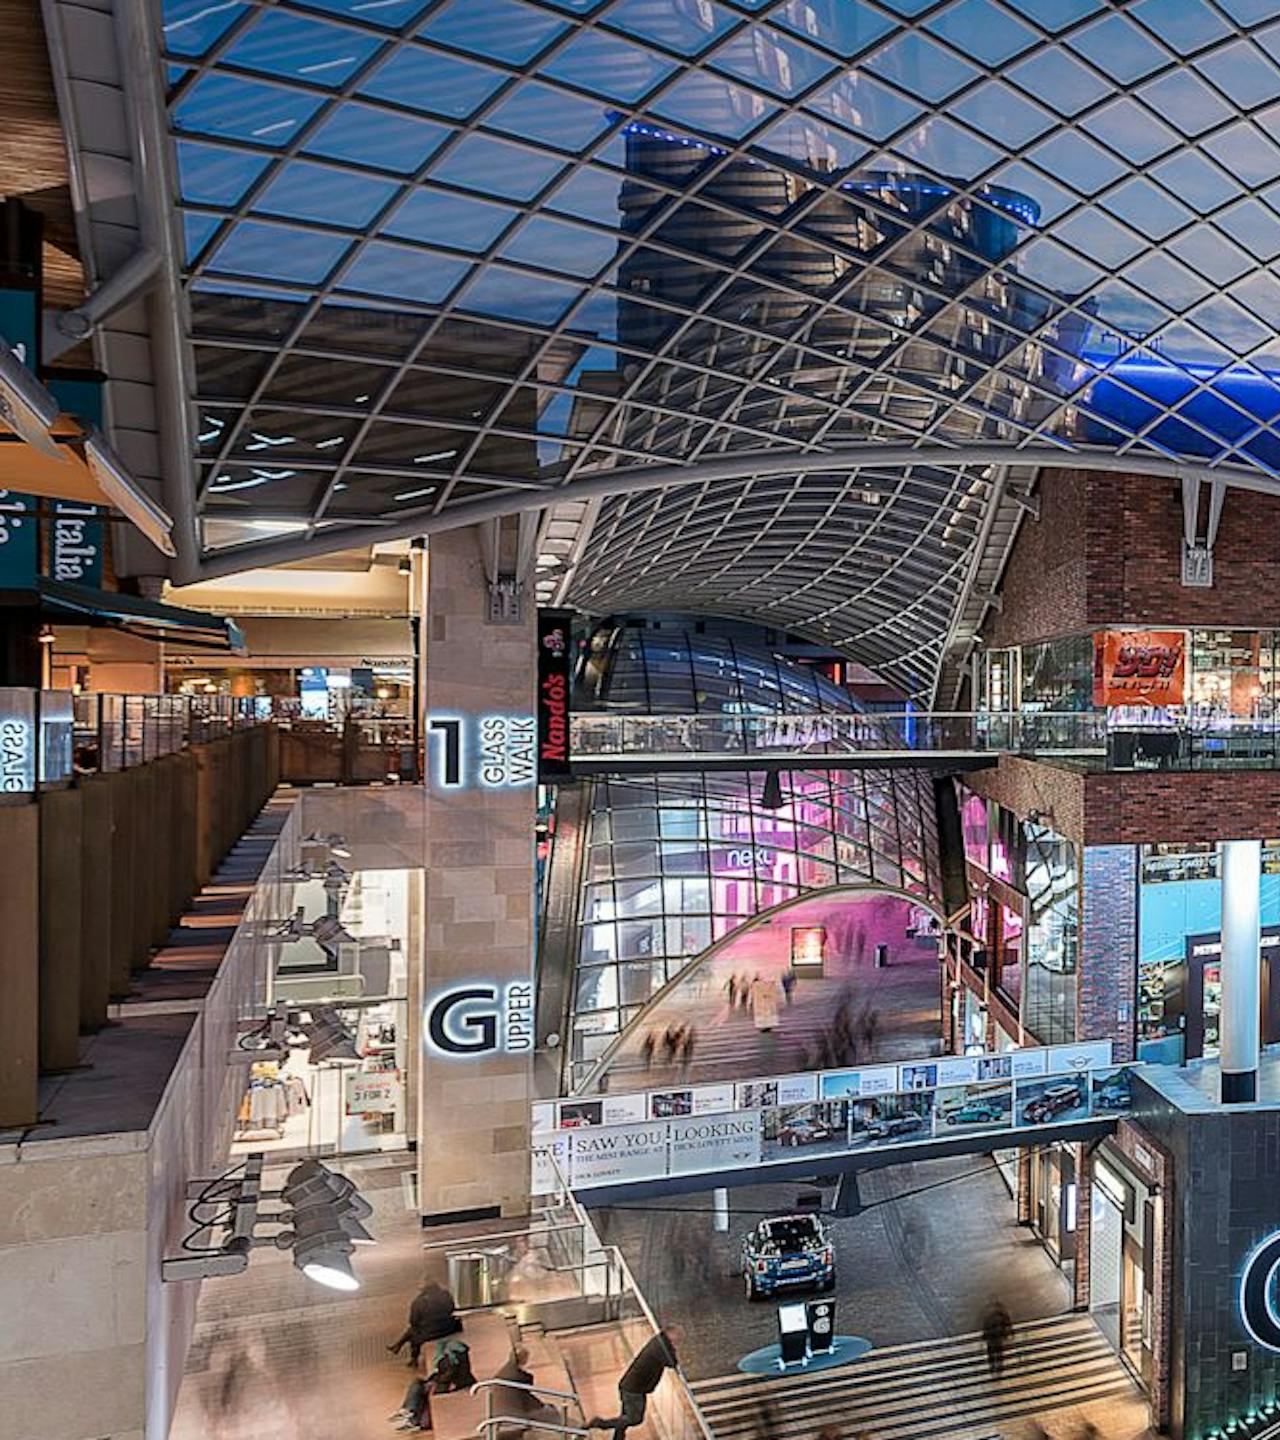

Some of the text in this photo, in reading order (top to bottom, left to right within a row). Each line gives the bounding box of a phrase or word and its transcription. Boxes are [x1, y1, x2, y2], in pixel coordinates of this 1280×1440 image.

[55, 504, 97, 581] Italia
[542, 673, 566, 761] Nando's
[430, 719, 505, 784] 1 GLASS
[511, 719, 534, 783] WALK
[429, 985, 531, 1053] G UPPER
[577, 1137, 619, 1153] SAW
[625, 1131, 661, 1147] YOU
[674, 1120, 753, 1141] LOOKING
